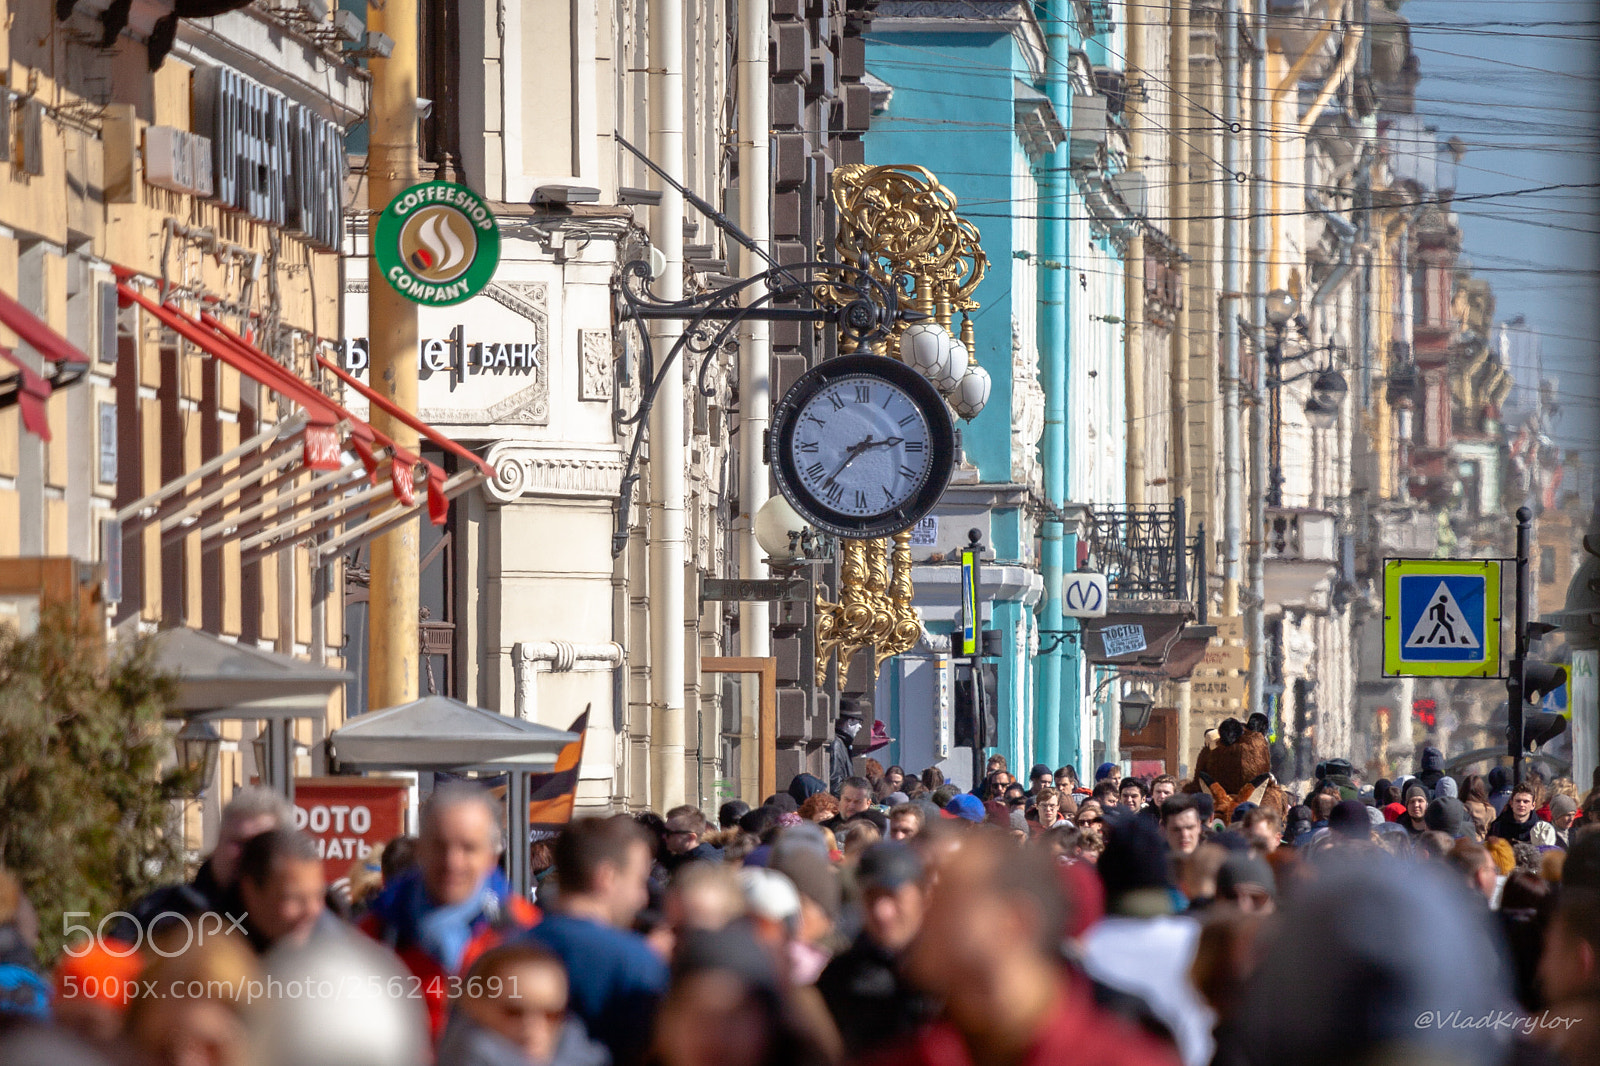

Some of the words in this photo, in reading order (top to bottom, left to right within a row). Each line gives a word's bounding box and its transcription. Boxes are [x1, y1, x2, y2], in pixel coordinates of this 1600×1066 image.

[394, 185, 493, 231] COFFEESHOP
[388, 266, 471, 302] COMPANY
[482, 342, 541, 368] БАНК
[827, 392, 845, 412] XI
[855, 386, 869, 403] XII
[808, 413, 825, 428] X
[905, 442, 923, 452] III
